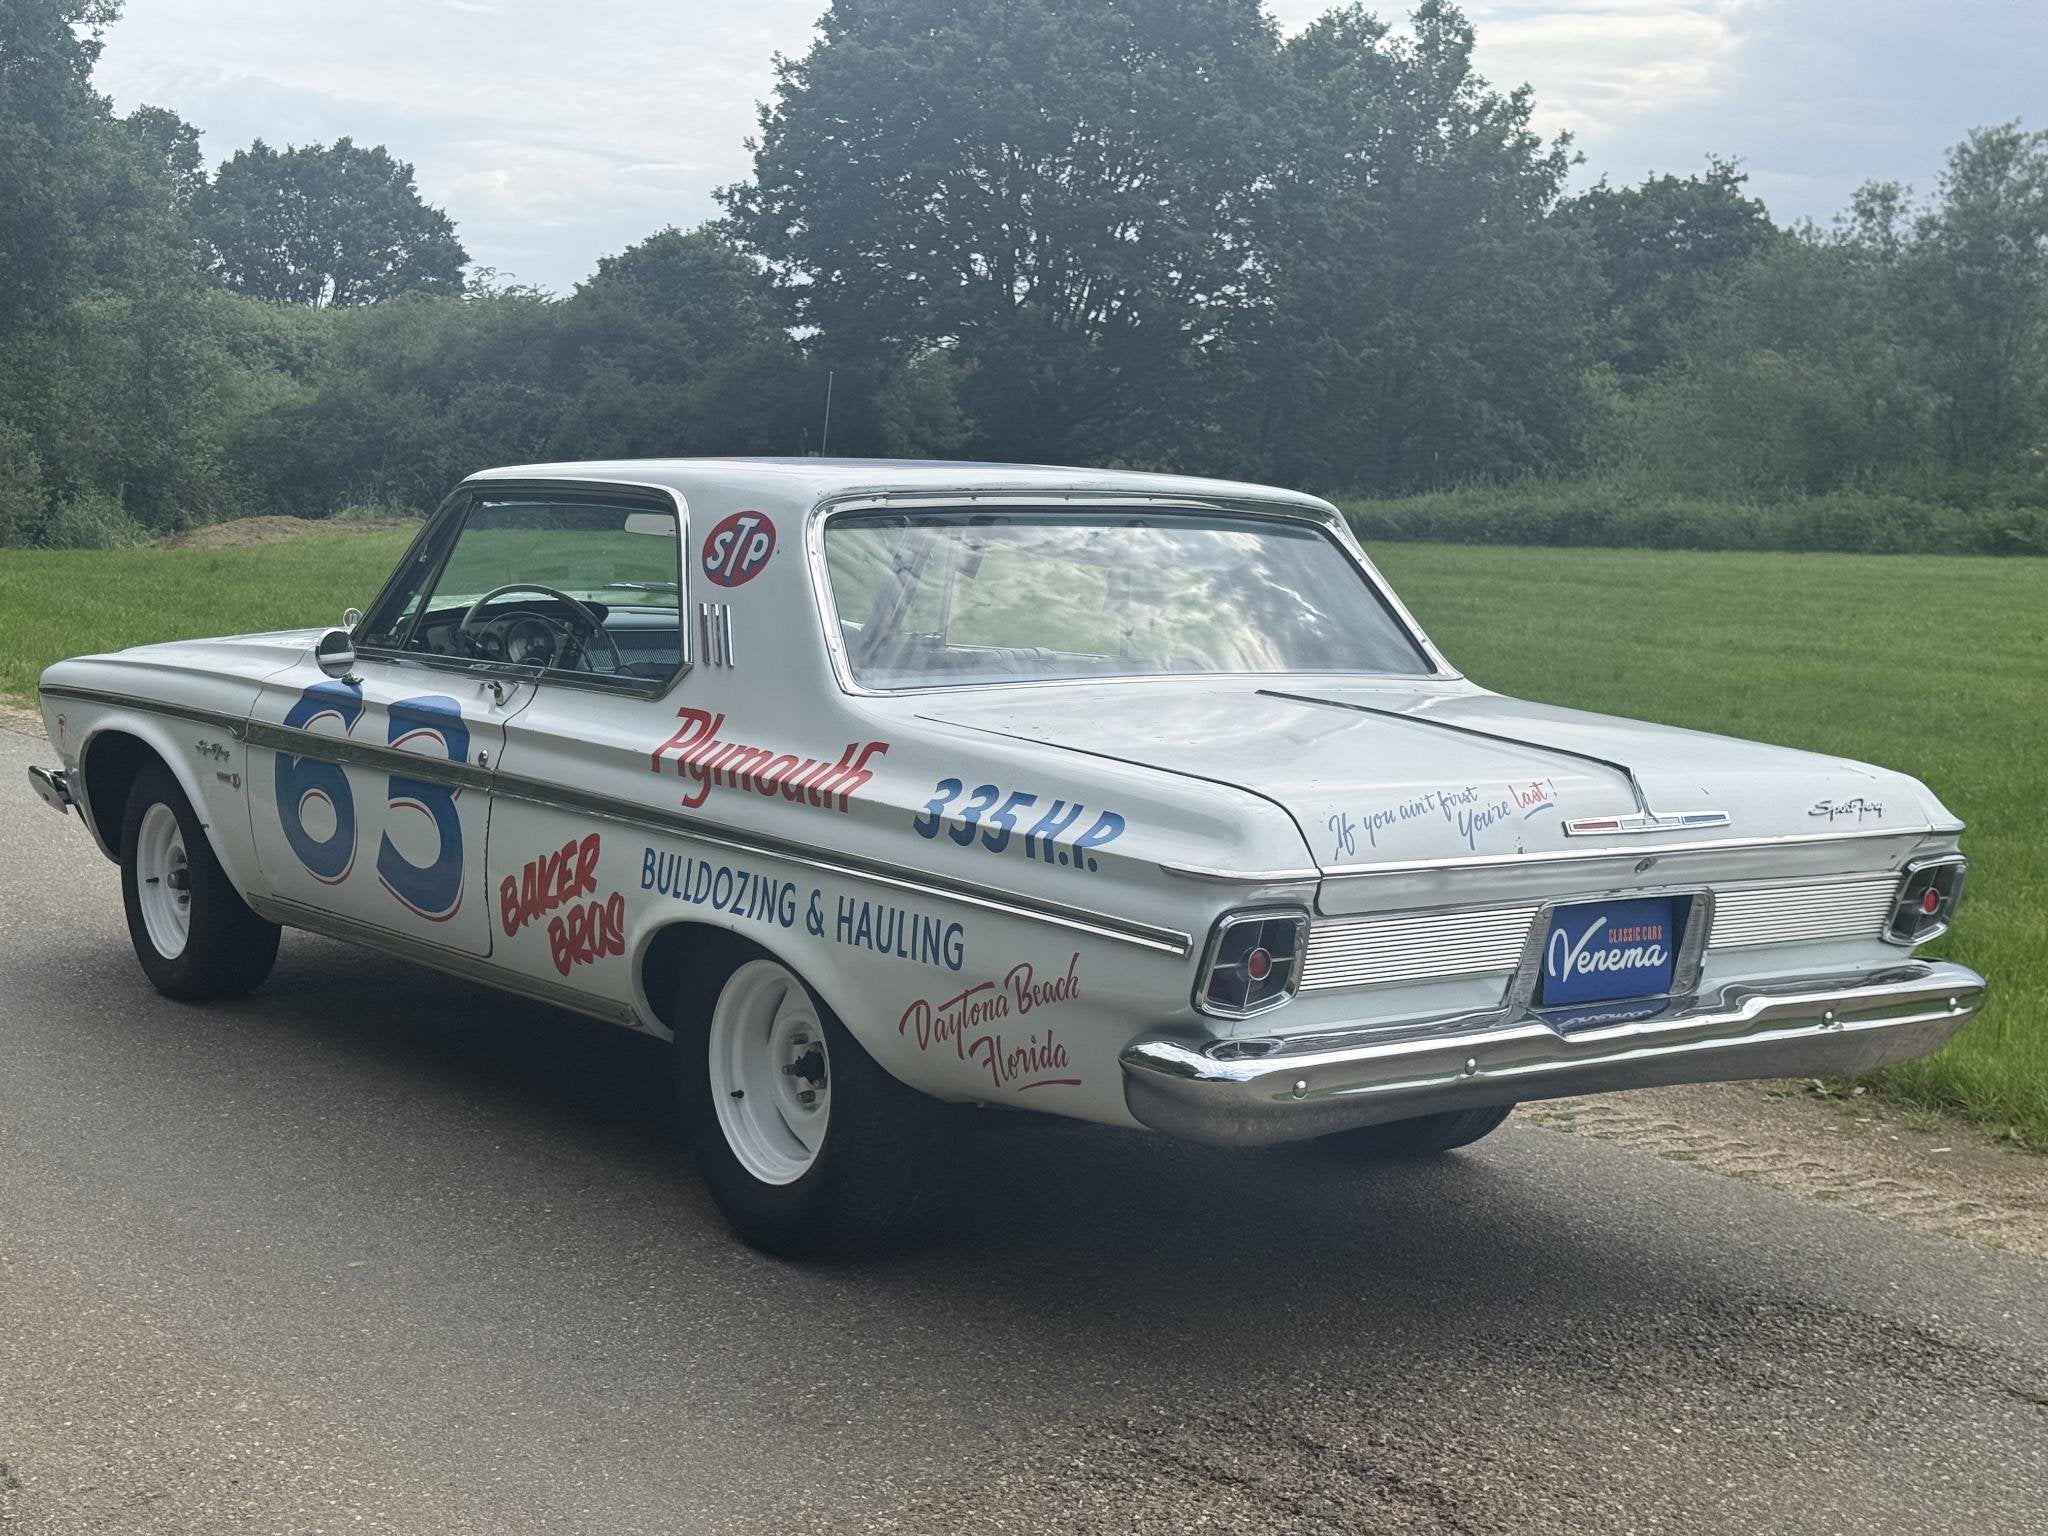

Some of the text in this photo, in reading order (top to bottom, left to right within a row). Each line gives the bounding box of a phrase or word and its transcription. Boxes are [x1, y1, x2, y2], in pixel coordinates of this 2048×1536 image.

[705, 517, 769, 577] STP
[274, 681, 470, 922] 63
[651, 707, 890, 813] Plymouth
[913, 777, 1126, 872] 335 H.P.
[1329, 786, 1478, 856] If you ain't first
[1458, 778, 1558, 850] You're last!
[500, 832, 601, 938] BAKER
[641, 847, 965, 971] BULLDOZING & HAULING
[547, 891, 626, 977] BROS
[1548, 916, 1668, 983] Venema
[1608, 925, 1663, 944] CLASSIC CARS
[899, 952, 1081, 1060] Daytona Beach
[969, 1029, 1069, 1087] Florida
